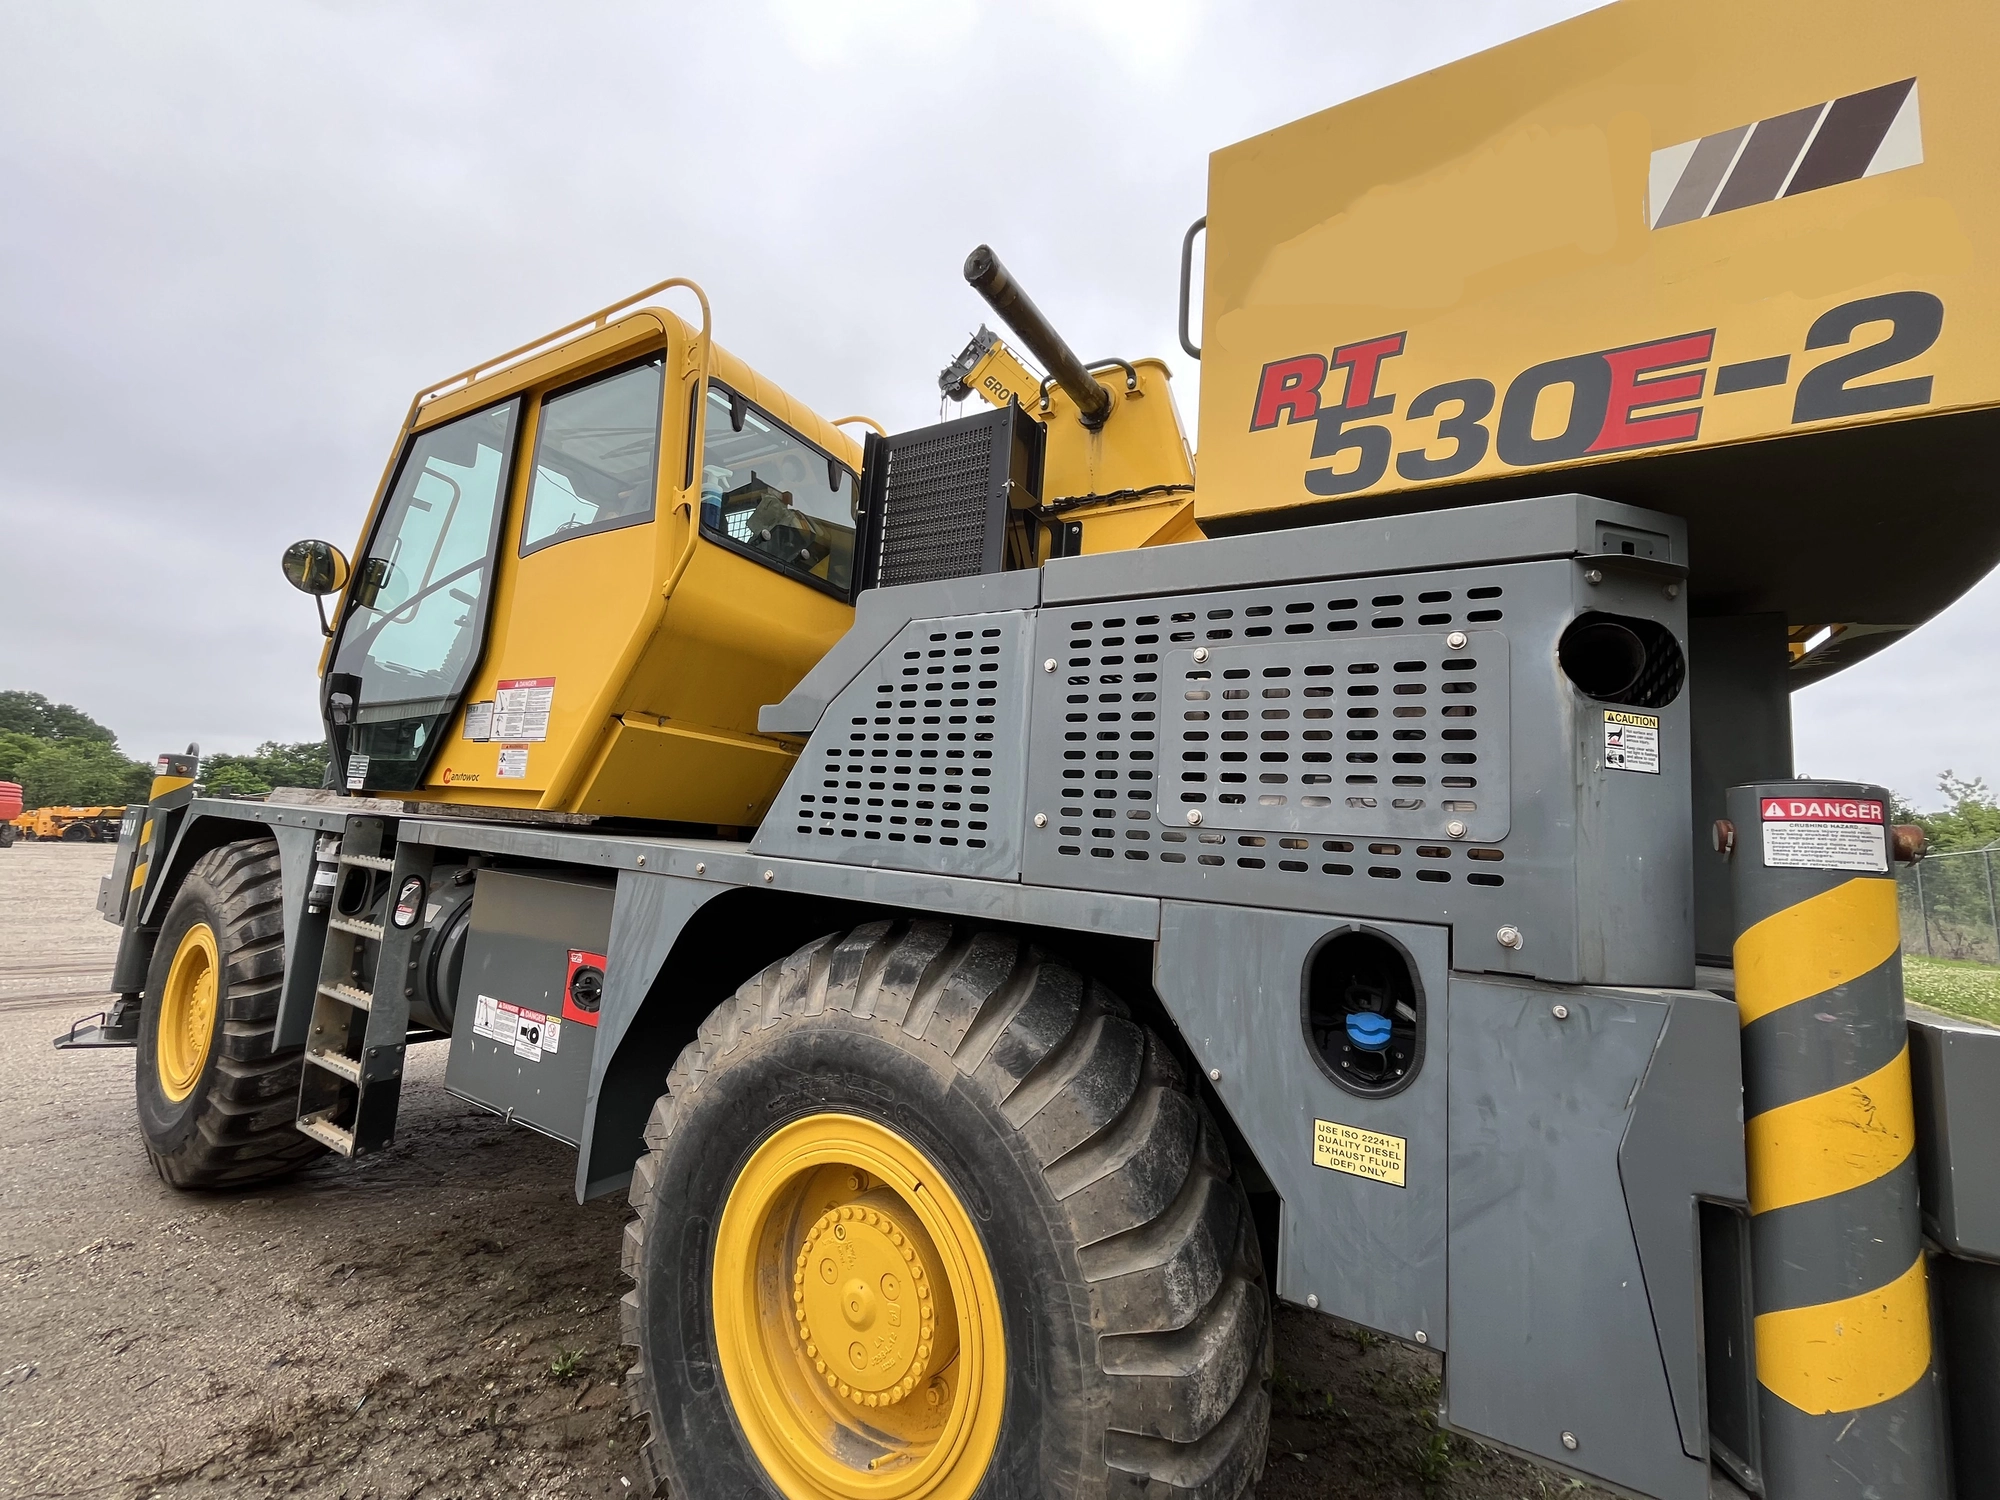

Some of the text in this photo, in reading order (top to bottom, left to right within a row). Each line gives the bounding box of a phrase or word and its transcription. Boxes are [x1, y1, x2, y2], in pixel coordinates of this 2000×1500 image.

[984, 376, 1022, 406] GRO
[1249, 330, 1407, 433] RT
[1303, 290, 1944, 496] 530E-2
[1616, 714, 1656, 726] CAUTION
[1790, 802, 1882, 820] DANGER
[525, 1010, 545, 1023] DANGER
[1318, 1135, 1401, 1160] QUALITY DIESEL
[1319, 1124, 1400, 1149] USE ISO 22241-1
[1319, 1145, 1399, 1170] EXHAUST FLUID
[1330, 1158, 1386, 1177] (DEF) ONLY
